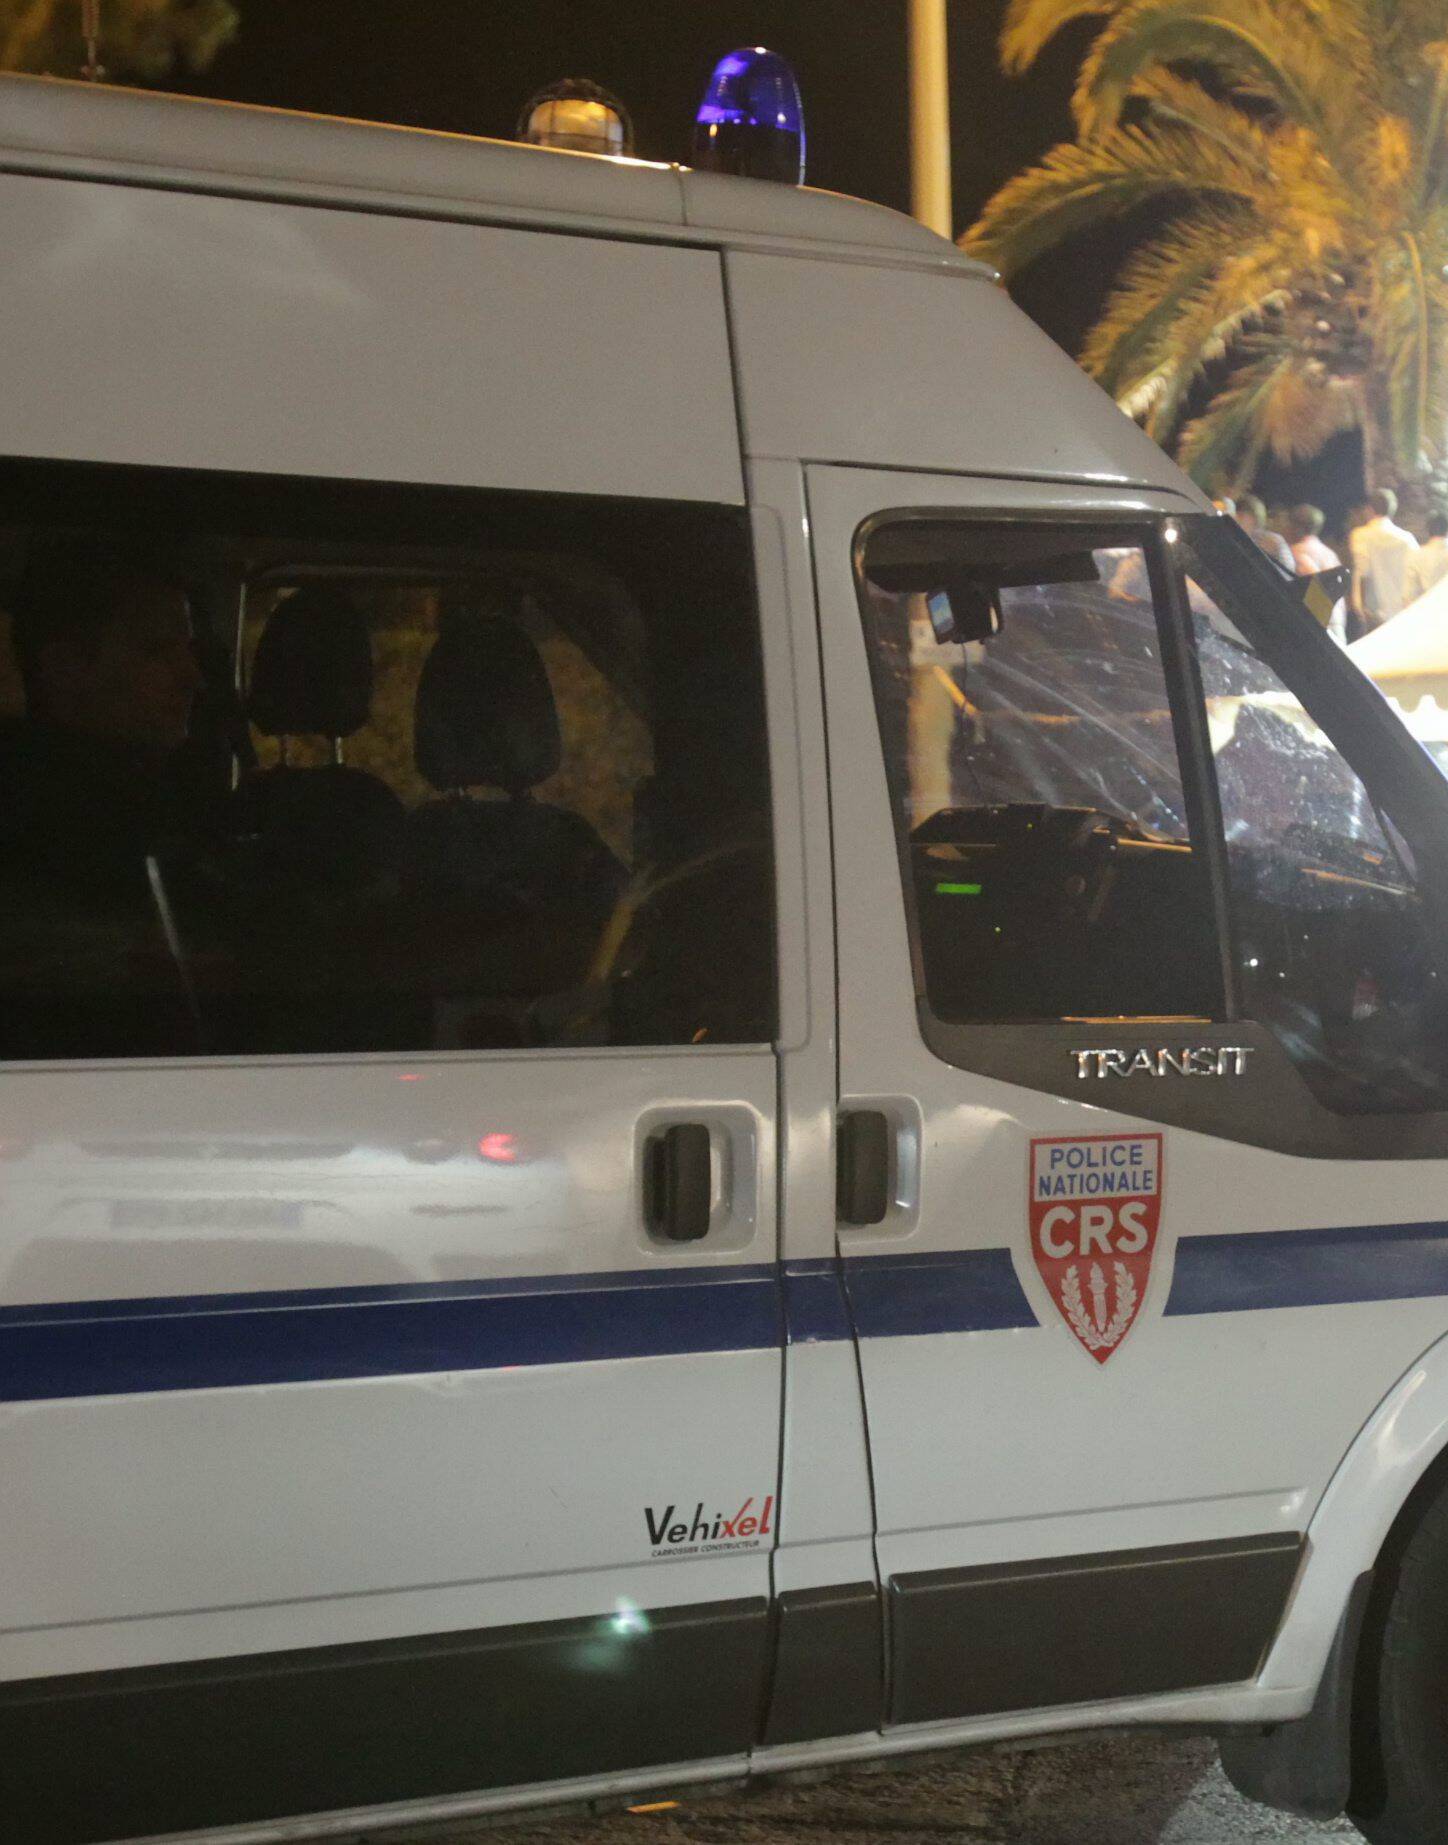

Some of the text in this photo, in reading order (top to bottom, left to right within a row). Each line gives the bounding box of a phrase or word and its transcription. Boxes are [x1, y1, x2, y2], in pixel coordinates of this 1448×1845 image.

[1070, 1047, 1255, 1079] TRANSIT
[1050, 1144, 1144, 1171] POLICE
[1038, 1169, 1154, 1197] NATIONALE
[1039, 1201, 1149, 1259] CRS
[644, 1495, 774, 1546] Vehixel
